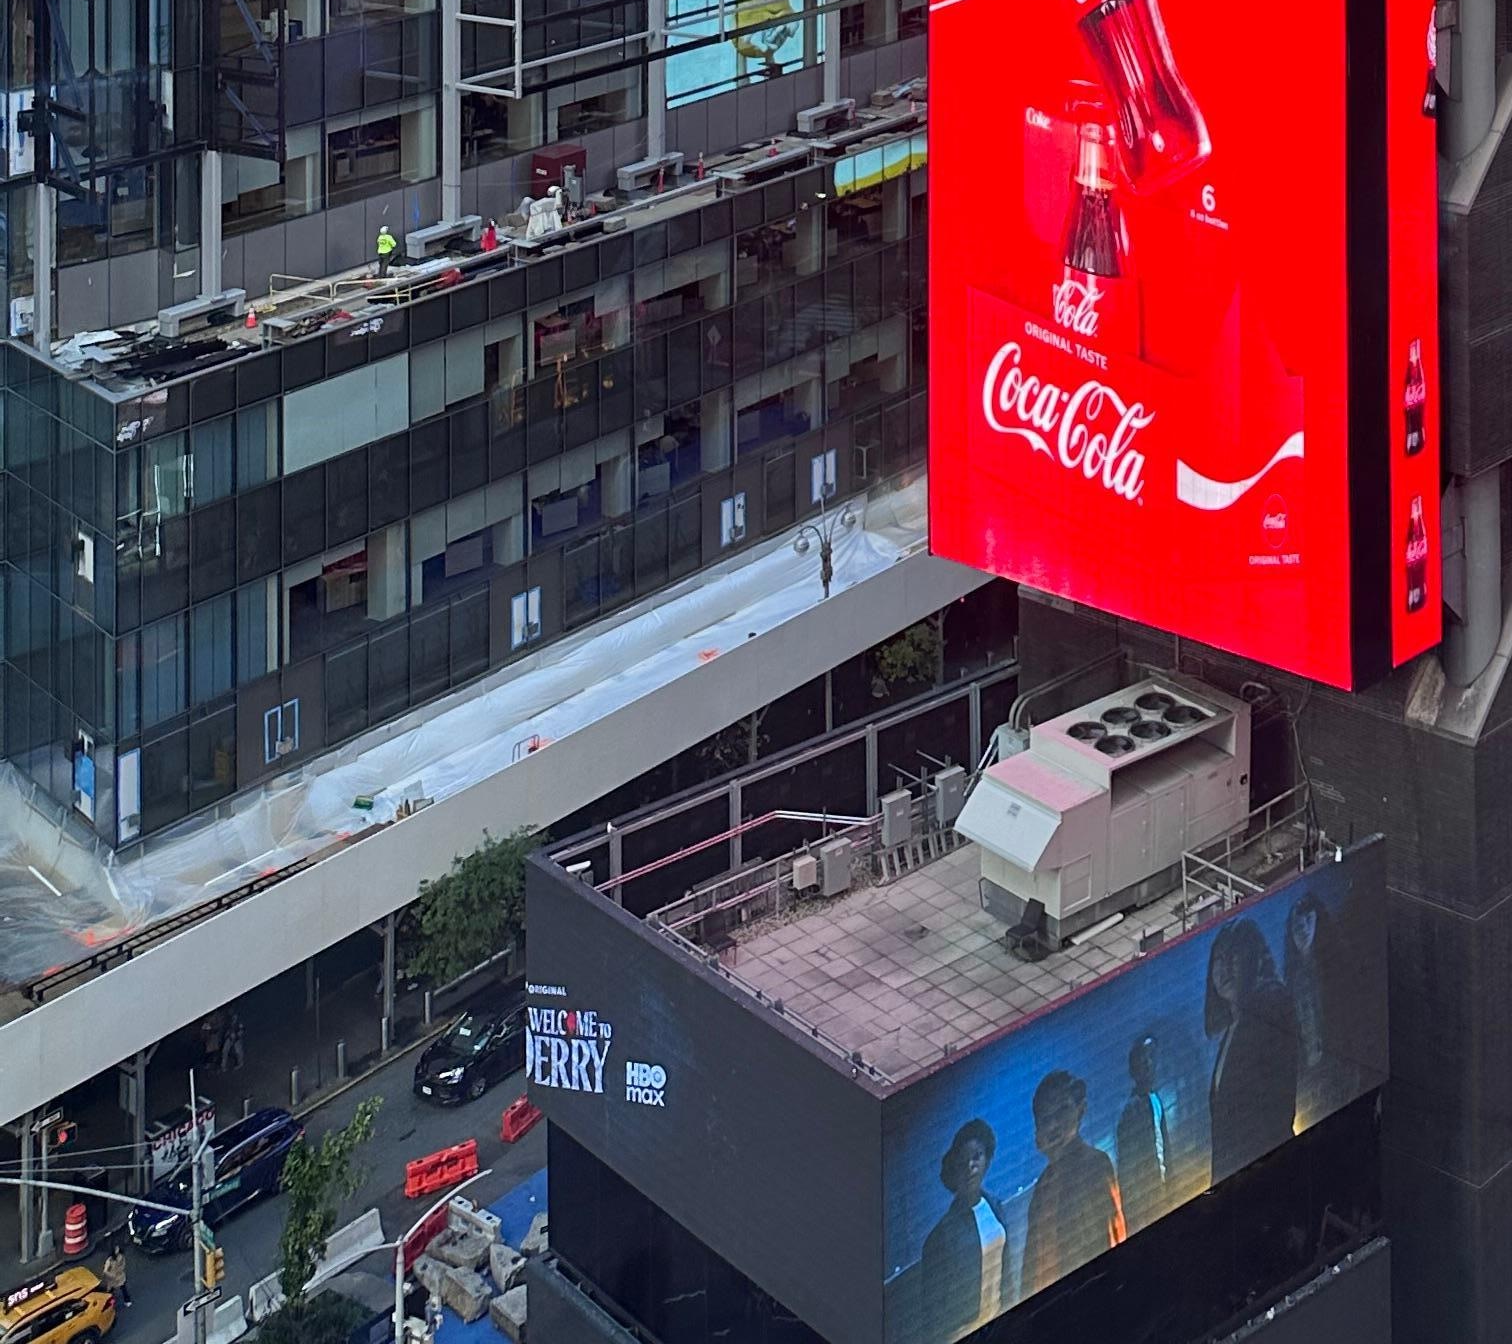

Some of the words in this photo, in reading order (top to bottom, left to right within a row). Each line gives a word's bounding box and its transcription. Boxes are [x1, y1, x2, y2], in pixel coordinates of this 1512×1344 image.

[1202, 184, 1216, 212] 6
[1025, 321, 1073, 355] ORIGINAL
[1075, 343, 1109, 371] TASTE
[983, 341, 1156, 504] Coca-Cola
[528, 984, 567, 997] ORIGINAL
[600, 1022, 612, 1039] TO
[626, 1061, 667, 1089] HBO
[626, 1086, 665, 1107] max
